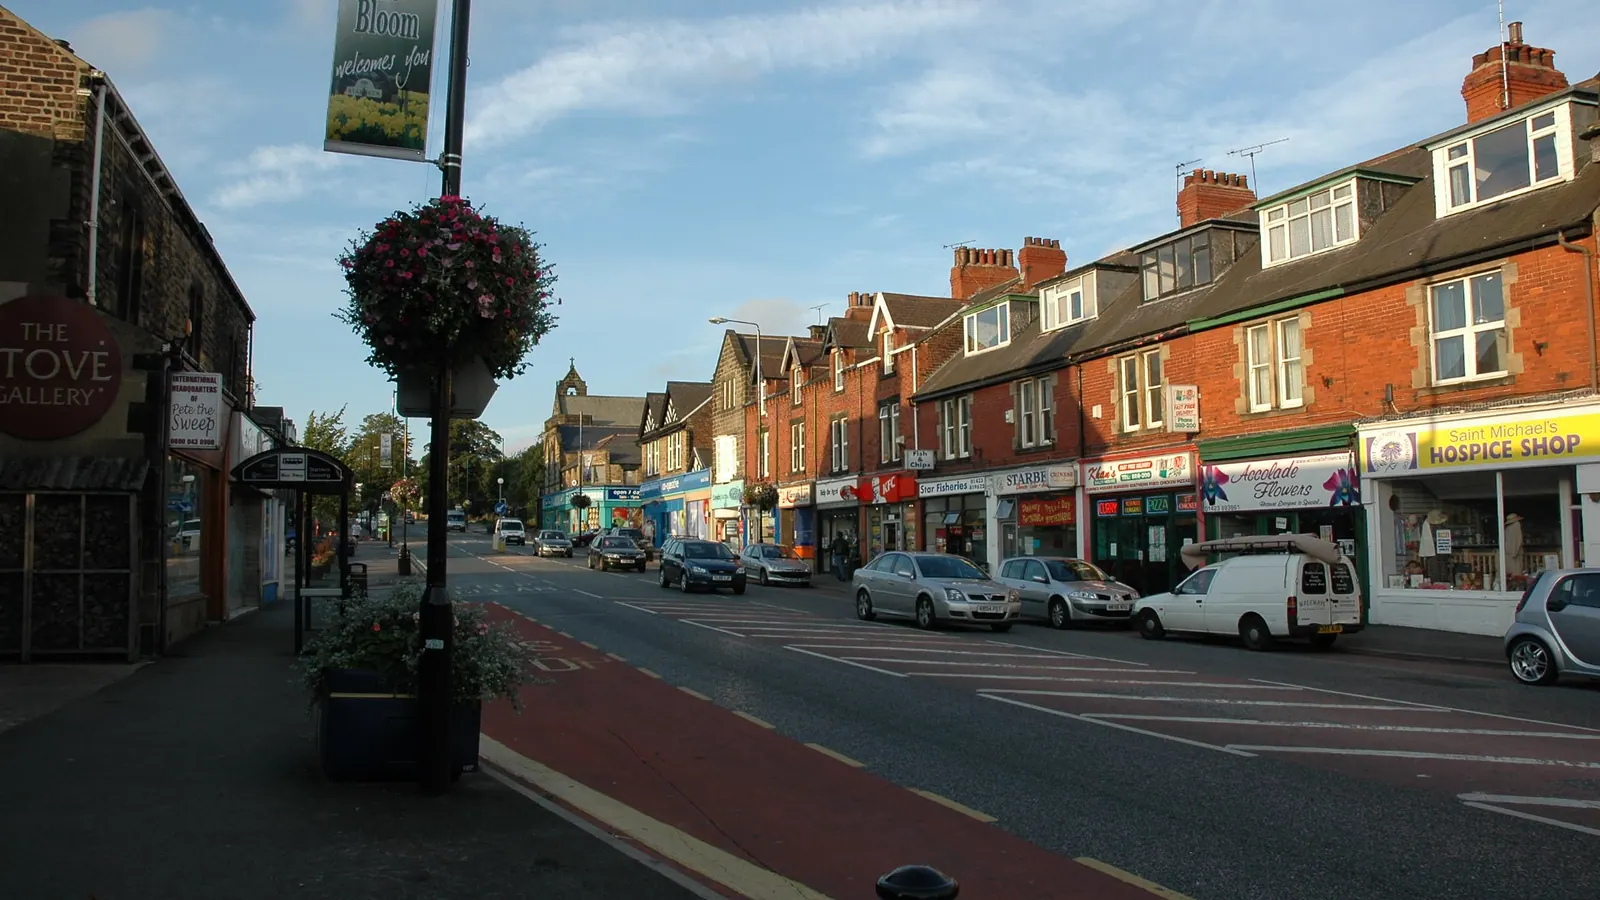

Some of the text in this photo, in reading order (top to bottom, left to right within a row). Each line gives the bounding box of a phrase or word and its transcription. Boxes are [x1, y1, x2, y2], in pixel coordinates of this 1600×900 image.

[354, 0, 420, 39] Bloom
[336, 45, 430, 89] welcomes you
[20, 322, 69, 342] THE
[172, 375, 217, 383] INTERNATIONAL
[172, 385, 217, 393] HEADQUARTERS
[172, 402, 215, 415] Pete the
[171, 414, 215, 437] Sweep
[1449, 420, 1558, 443] Saint Michael's
[1430, 434, 1581, 464] HOSPICE SHOP
[1006, 470, 1046, 487] STARBE
[1088, 465, 1116, 480] Khan's
[1230, 461, 1299, 484] Accolade
[882, 476, 896, 495] KFC
[920, 480, 967, 494] Star Fisheries
[1253, 481, 1313, 499] Flowers
[1099, 502, 1117, 514] CURRY
[1148, 499, 1168, 511] PIZZA
